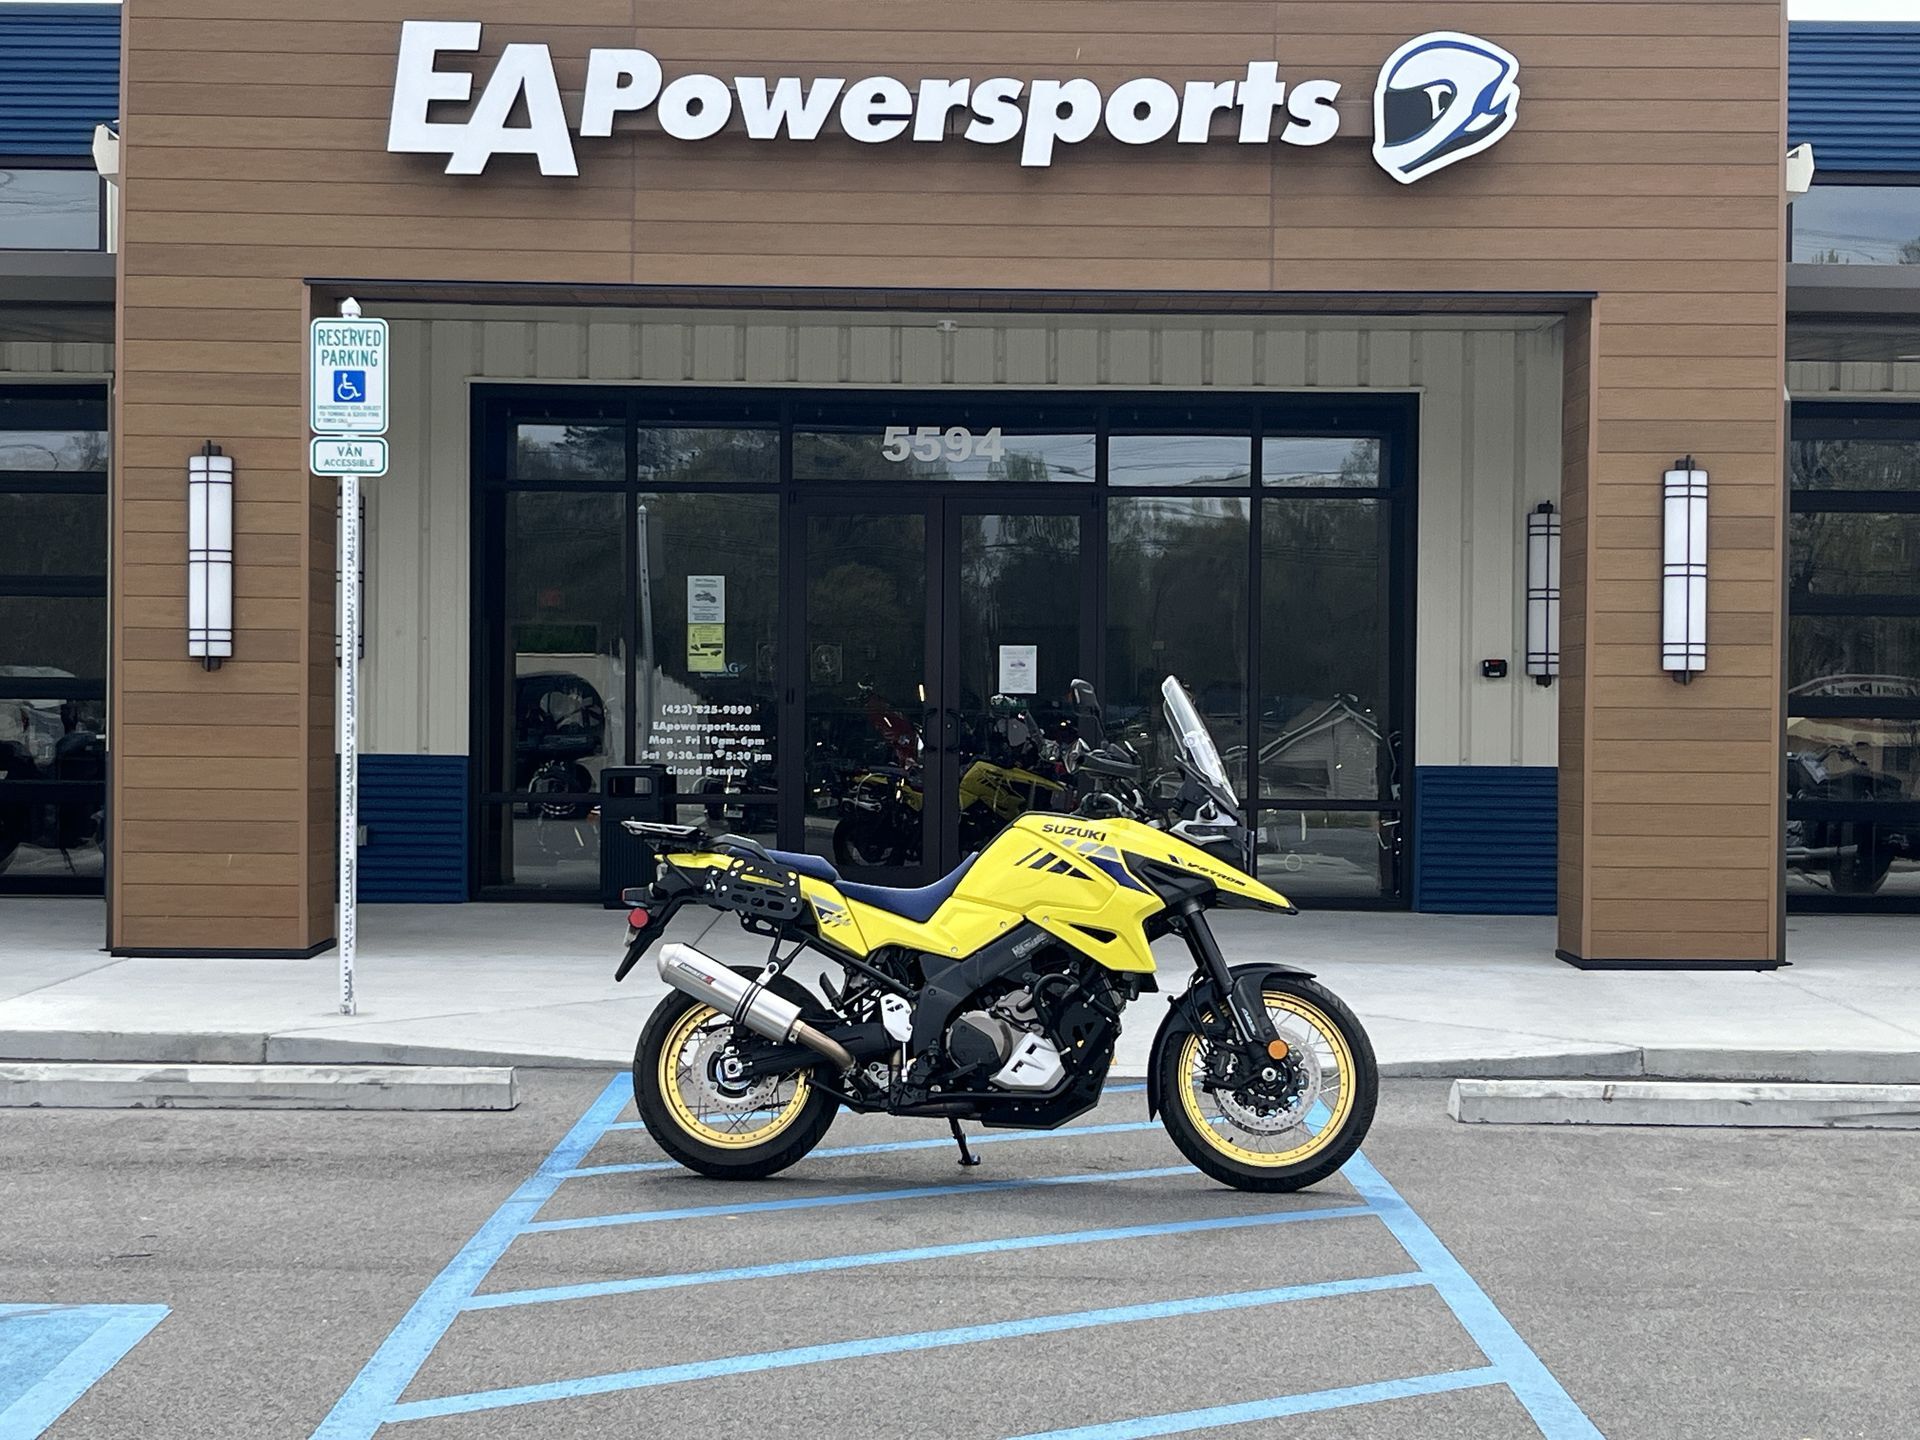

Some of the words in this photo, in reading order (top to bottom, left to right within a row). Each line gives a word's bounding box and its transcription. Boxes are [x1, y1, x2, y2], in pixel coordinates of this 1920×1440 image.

[318, 328, 382, 347] RESERVED
[321, 349, 378, 367] PARKING
[882, 426, 1006, 463] 5594
[336, 446, 363, 457] VAN
[323, 458, 375, 467] ACCESSIBLE
[661, 704, 692, 715] (423)
[652, 722, 760, 732] EApowersports.com
[648, 736, 673, 745] Mon
[685, 735, 701, 745] Fri
[641, 752, 659, 760] Sat
[726, 752, 751, 761] 5:30
[754, 754, 771, 762] pm
[666, 767, 702, 775] Closed
[705, 767, 747, 777] Sunday
[1042, 823, 1107, 842] SUZUKI
